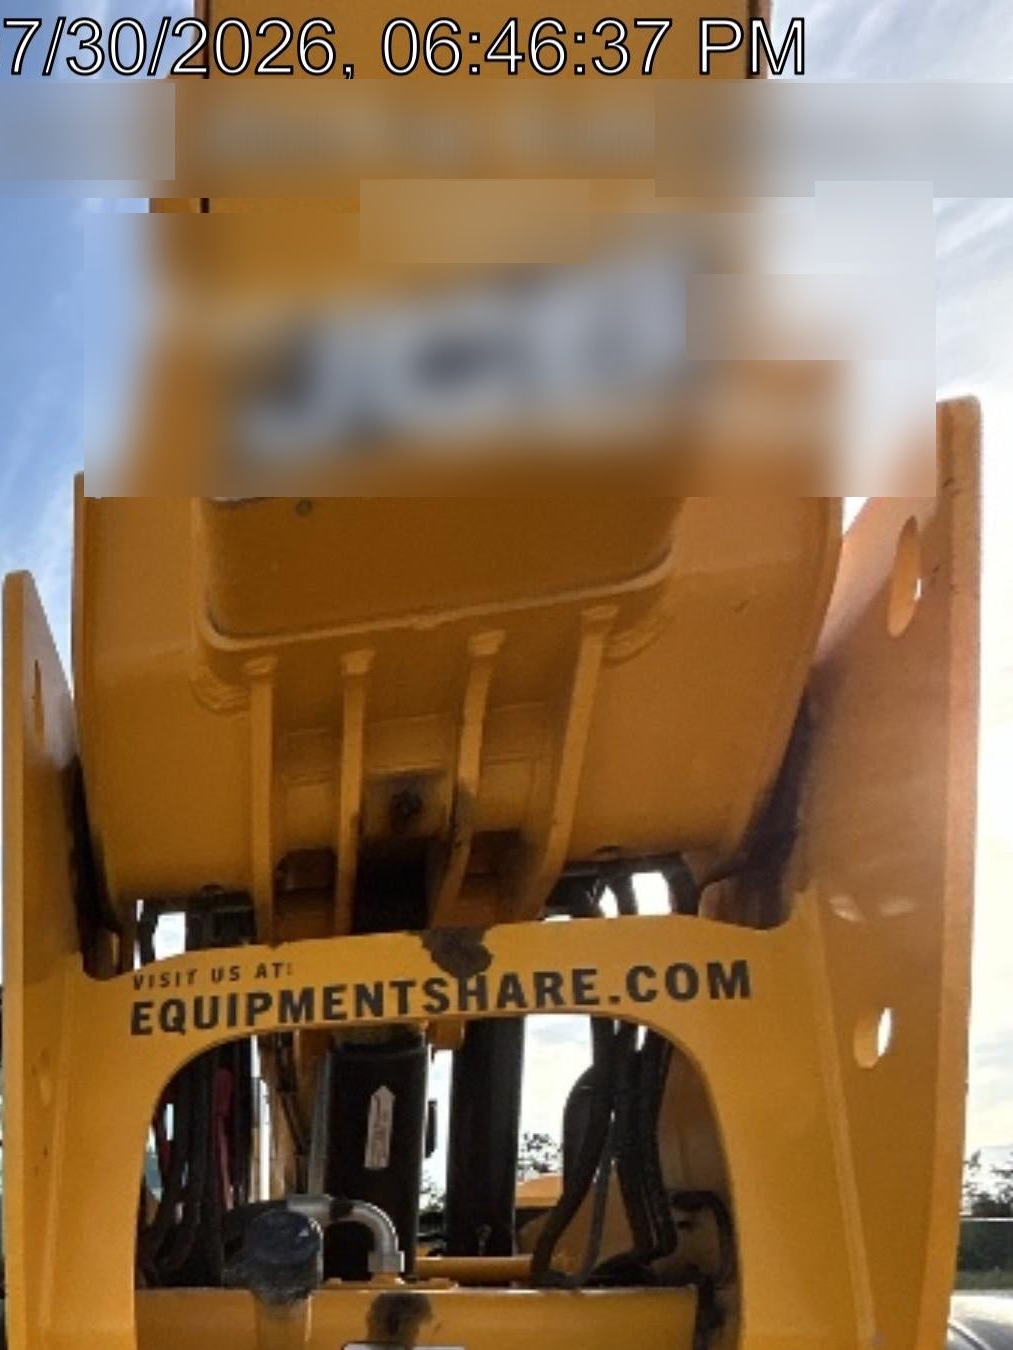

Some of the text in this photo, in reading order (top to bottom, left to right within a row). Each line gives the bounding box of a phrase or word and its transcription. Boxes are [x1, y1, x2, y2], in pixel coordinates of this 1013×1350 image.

[131, 960, 751, 1036] EQUIPMENTSHARE.COM
[133, 968, 198, 991] VISIT
[211, 965, 240, 984] US
